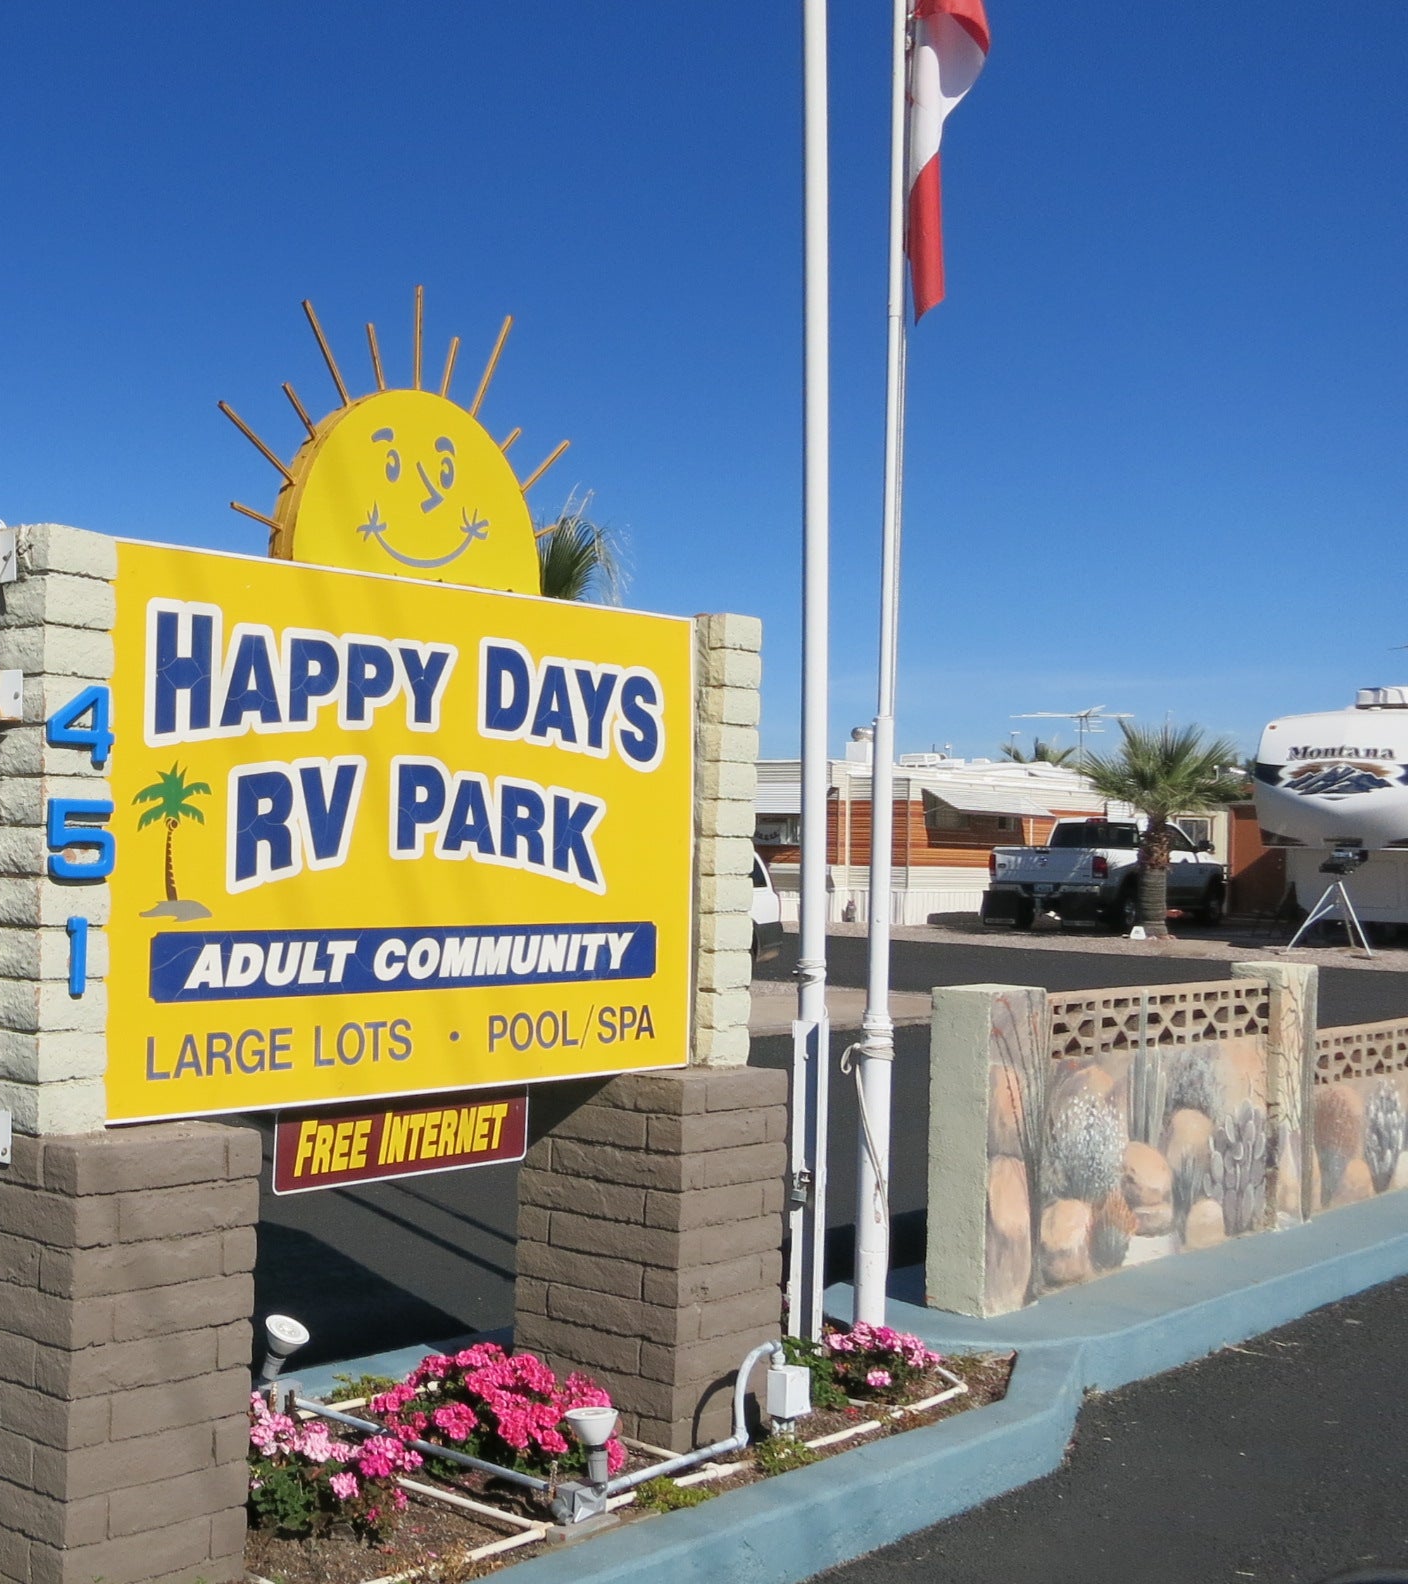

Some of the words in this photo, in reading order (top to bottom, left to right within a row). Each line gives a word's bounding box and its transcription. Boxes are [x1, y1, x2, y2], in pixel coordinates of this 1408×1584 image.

[150, 605, 453, 740] HAPPY
[482, 641, 662, 767] DAYS
[1286, 745, 1396, 761] Montana
[231, 760, 363, 888] RV
[393, 760, 604, 889] PARK
[183, 940, 359, 990] ADULT
[372, 932, 636, 982] COMMUNITY
[145, 1026, 294, 1081] LARGE
[313, 1018, 414, 1069] LOTS
[487, 1004, 656, 1054] POOL/SPA
[293, 1119, 373, 1178] FREE
[377, 1102, 509, 1166] INTERNET
